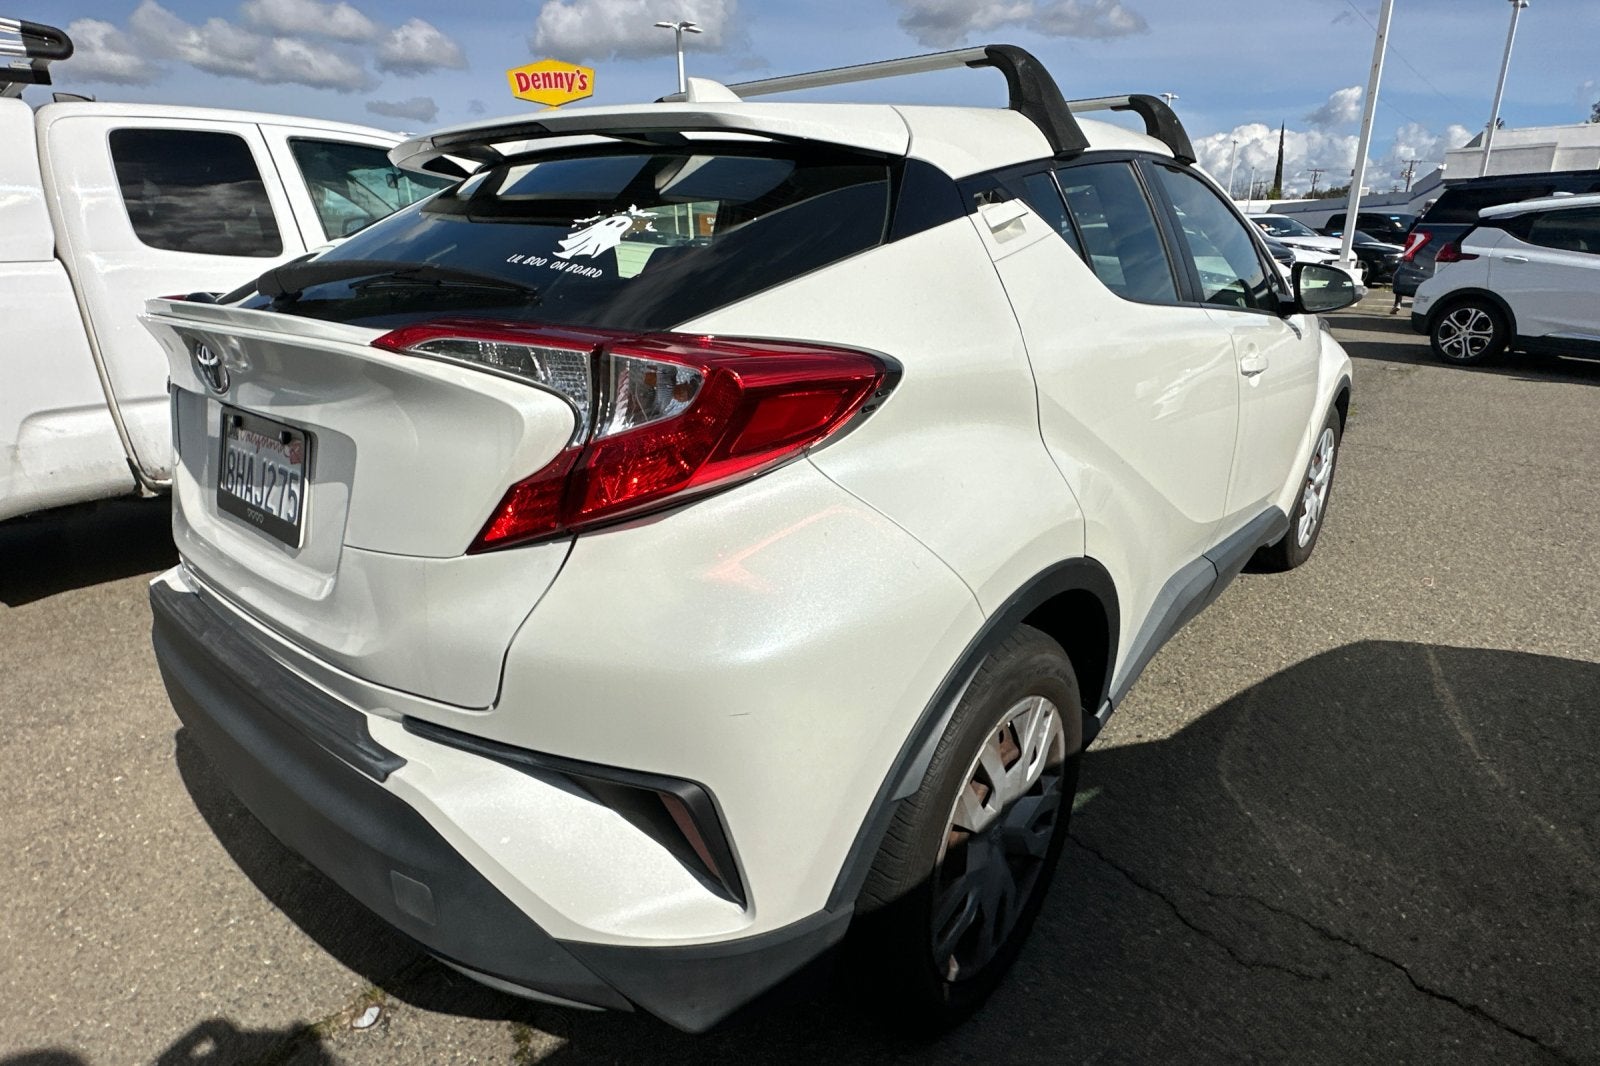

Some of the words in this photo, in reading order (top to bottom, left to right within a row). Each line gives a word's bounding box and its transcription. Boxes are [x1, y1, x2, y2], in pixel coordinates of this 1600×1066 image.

[515, 70, 587, 92] Denny's
[522, 256, 548, 267] BOO
[550, 261, 568, 272] ON
[565, 263, 602, 278] BOARD
[226, 449, 299, 524] 8HAJ275
